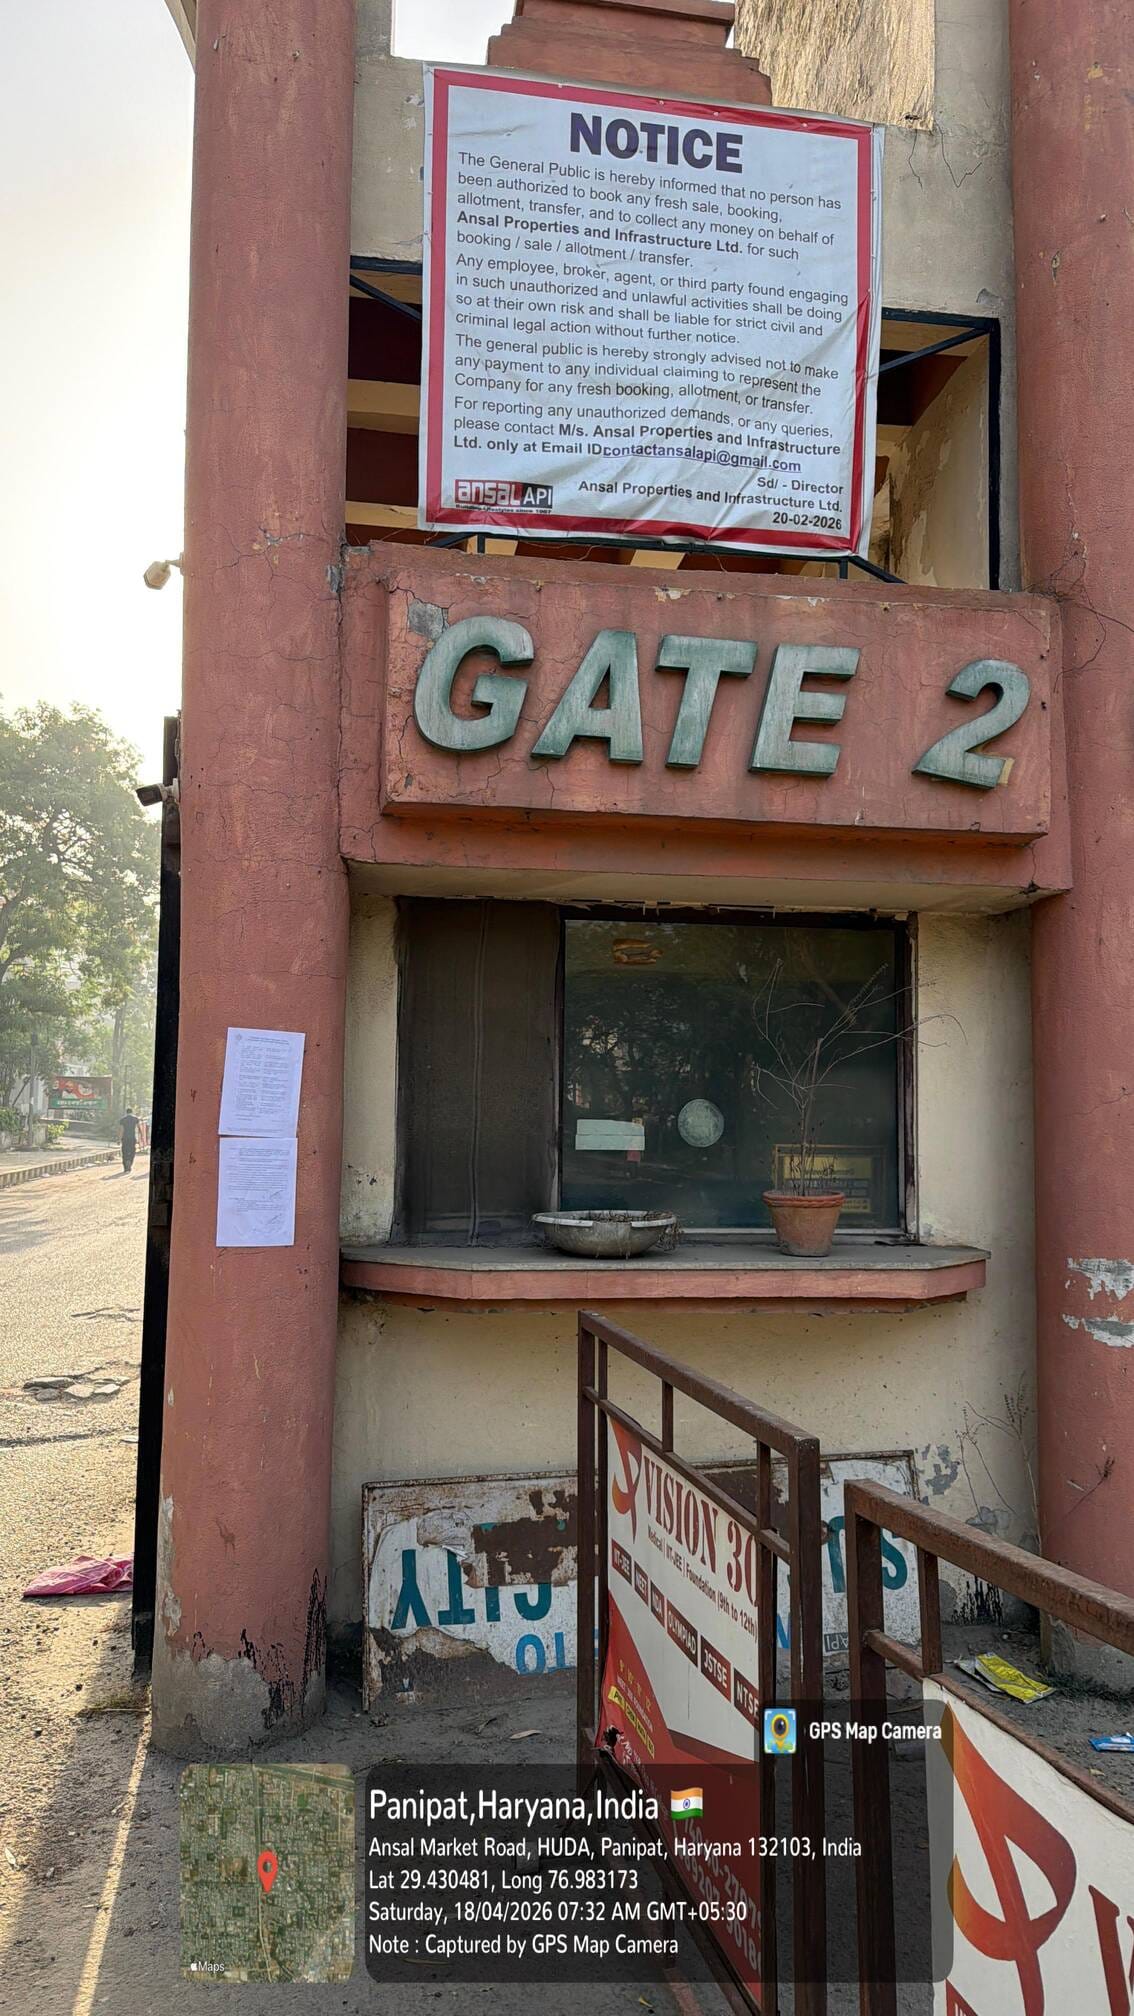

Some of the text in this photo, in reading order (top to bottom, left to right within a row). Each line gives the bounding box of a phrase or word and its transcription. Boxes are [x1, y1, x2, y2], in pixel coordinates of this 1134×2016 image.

[570, 112, 743, 174] NOTICE
[458, 152, 842, 210] The General Public is hereby informed that no person has
[458, 172, 782, 223] been authorized to book any fresh sale, booking,
[457, 211, 799, 260] Ansal Properties and Infrastructure Ltd. for such
[458, 192, 835, 246] allotment, transfer, and to collect any money on behalf of
[457, 231, 693, 268] booking / sale / allotment / transfer.
[456, 253, 848, 305] Any employee, broker, agent, or third party found engaging
[457, 273, 842, 323] in such unauthorized and unlawful activities shall be doing
[456, 295, 823, 336] so at their own risk and shall be liable for strict civil and
[456, 312, 740, 344] criminal legal action without further notice.
[454, 418, 841, 455] please contact M/s. Ansal Properties and Infrastructure
[454, 436, 482, 449] Ltd.
[487, 440, 519, 454] only
[523, 442, 537, 452] at
[542, 442, 583, 454] Email
[523, 487, 552, 506] API
[578, 481, 842, 512] Ansal Properties and Infrastructure Ltd.
[757, 477, 779, 489] Sd/
[791, 480, 844, 494] Director
[773, 512, 842, 530] 20-02-2026
[413, 615, 1032, 790] GATE 2
[644, 1456, 719, 1574] VISION
[686, 1561, 717, 1603] Foundation
[732, 1603, 739, 1623] to
[668, 1610, 697, 1656] OLYMPIAD
[704, 1652, 728, 1688] JSTSE
